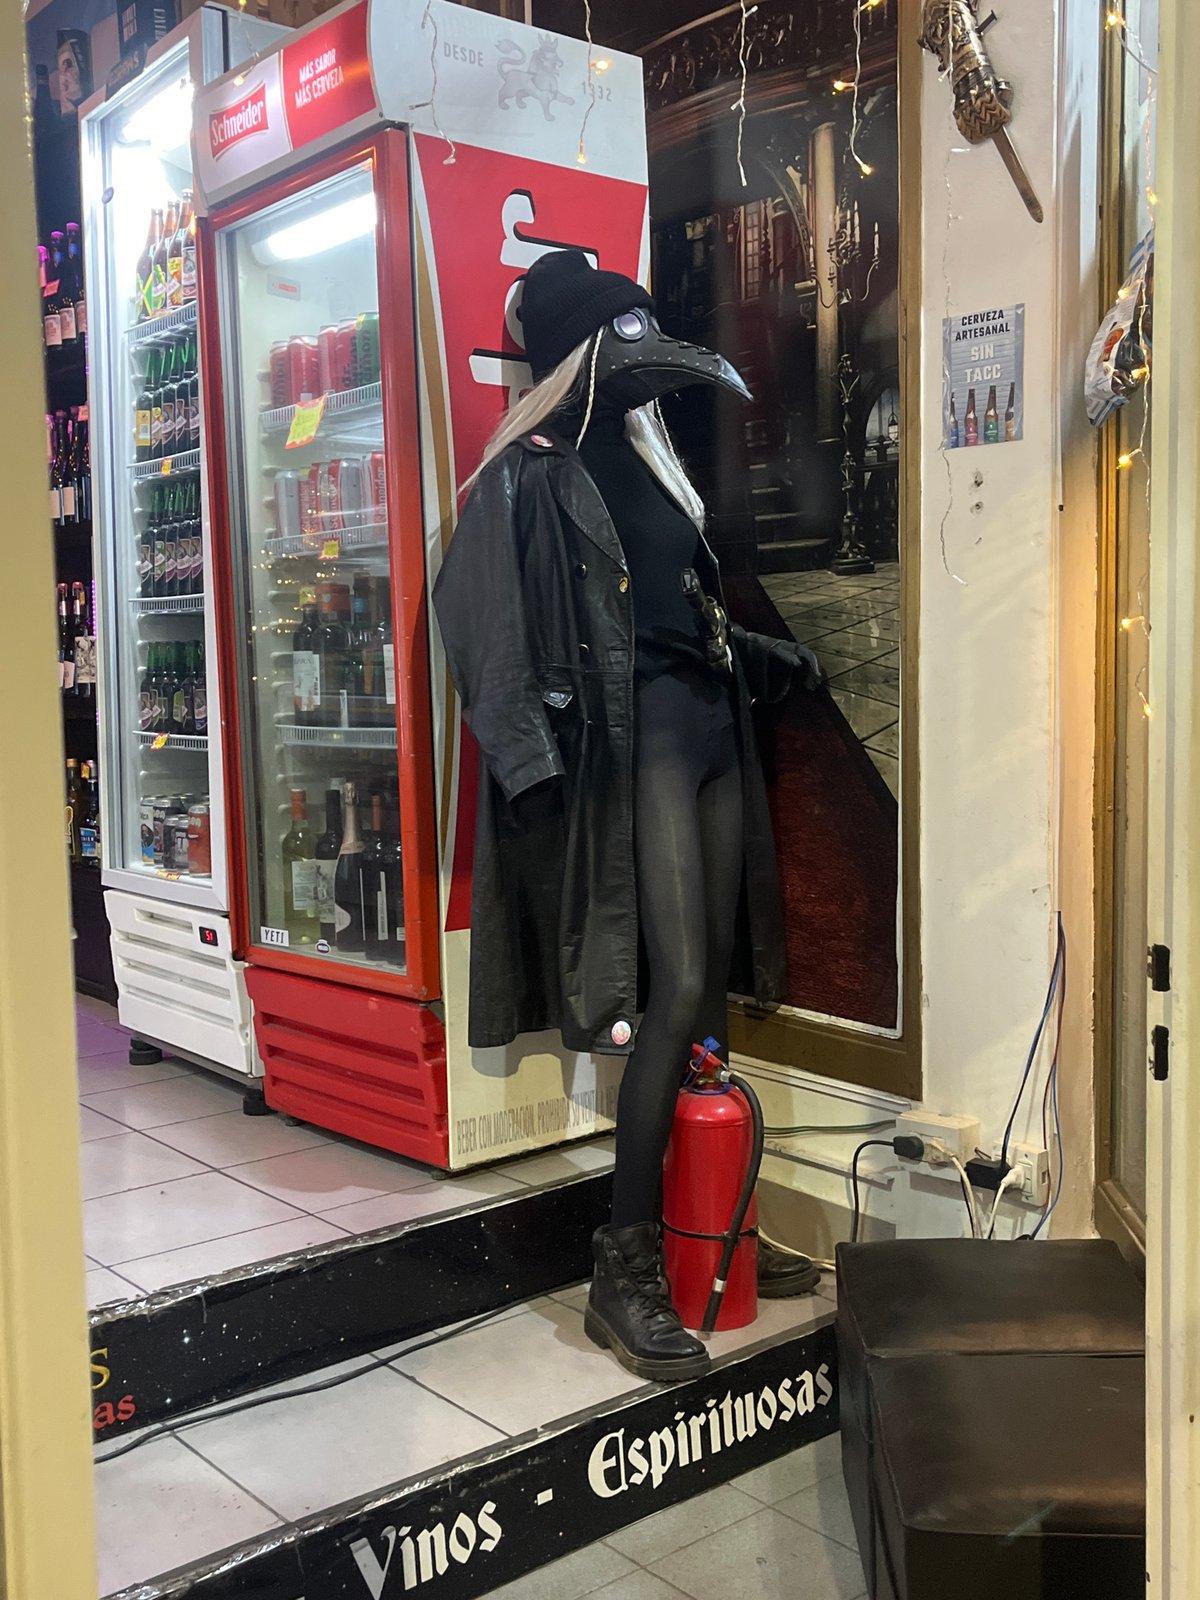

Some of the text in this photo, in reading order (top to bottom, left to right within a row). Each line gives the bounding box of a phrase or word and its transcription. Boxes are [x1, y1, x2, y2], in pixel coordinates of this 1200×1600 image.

[299, 48, 337, 83] MÁS SABOR
[443, 42, 484, 67] DESDE
[295, 65, 345, 109] MÁS CERVEZA
[211, 99, 264, 147] Schneider
[961, 309, 1004, 326] CERVEZA
[955, 322, 1010, 341] ARTESANAL
[970, 343, 994, 361] SIN
[964, 364, 1001, 383] TACC
[264, 928, 284, 943] YETI
[457, 1117, 477, 1155] BEBER
[479, 1114, 492, 1150] CON
[350, 1500, 502, 1600] Vinos
[588, 1363, 833, 1498] Espirituosas
